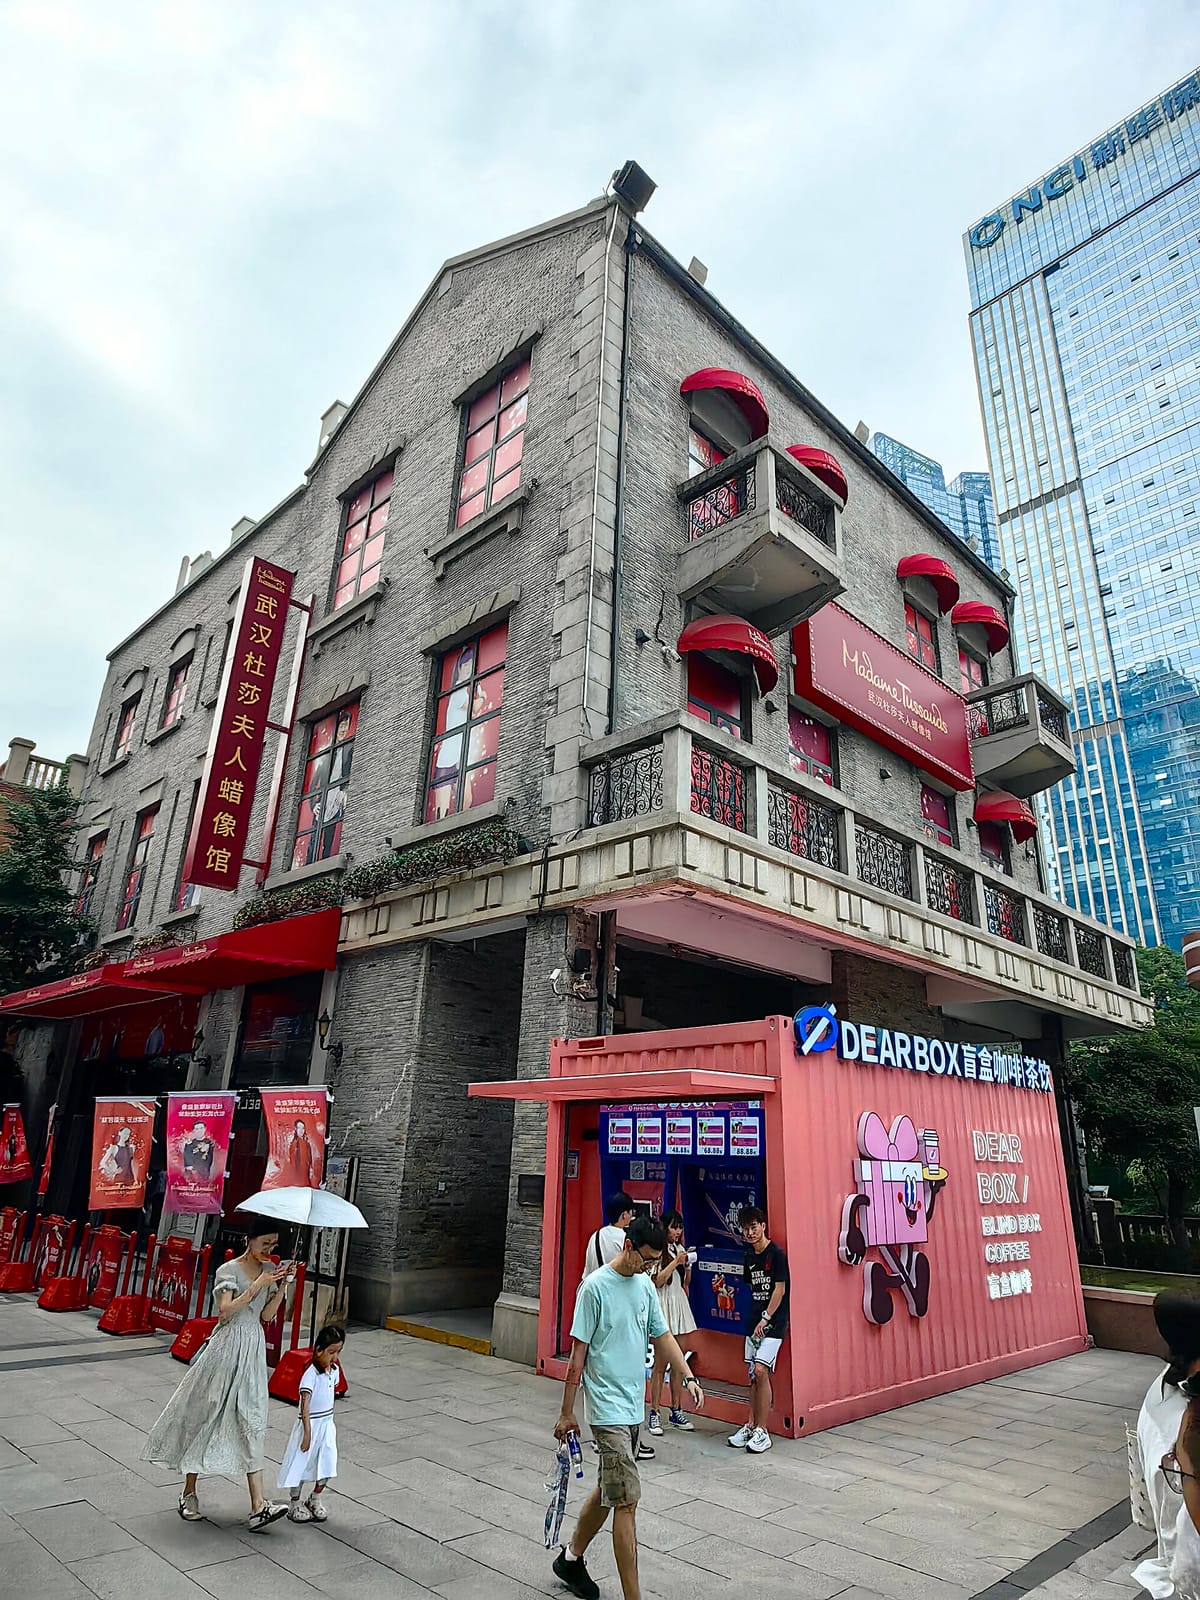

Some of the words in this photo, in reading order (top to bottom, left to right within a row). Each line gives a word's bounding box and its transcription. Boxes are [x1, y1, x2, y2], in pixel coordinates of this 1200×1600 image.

[1011, 155, 1087, 224] NCI
[842, 639, 902, 703] Madame
[896, 679, 948, 734] Tussauds
[205, 593, 278, 874] 武汉杜莎夫人蜡像馆
[972, 1130, 1023, 1163] DEAR
[976, 1172, 1019, 1205] BOX
[981, 1215, 1018, 1237] BLIND
[1018, 1213, 1042, 1233] BOX
[985, 1240, 1031, 1264] COFFEE
[987, 1268, 1032, 1300] 盲盒咖啡
